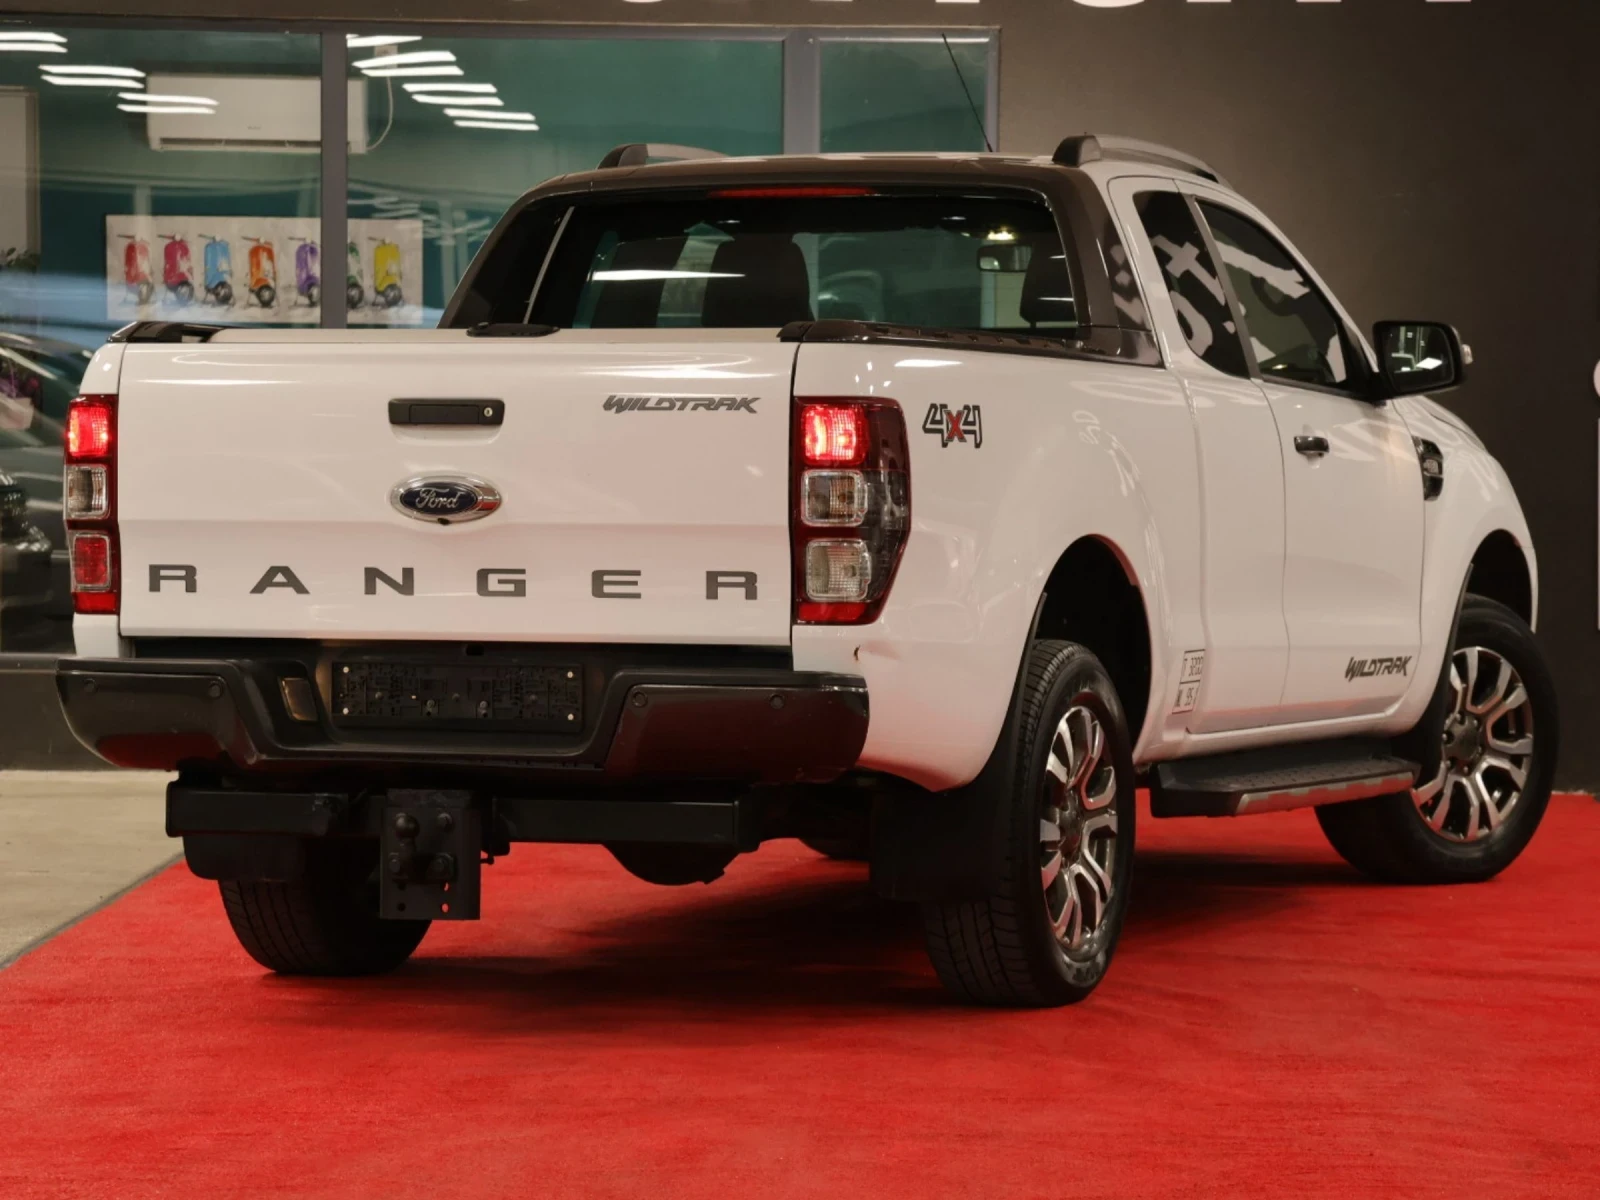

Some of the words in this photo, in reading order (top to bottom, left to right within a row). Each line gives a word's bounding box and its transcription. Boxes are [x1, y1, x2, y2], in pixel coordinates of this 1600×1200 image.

[603, 394, 760, 414] WILDTRAK
[415, 487, 462, 511] Ford
[149, 564, 758, 600] RANGER
[1345, 656, 1413, 682] WILDTRAK
